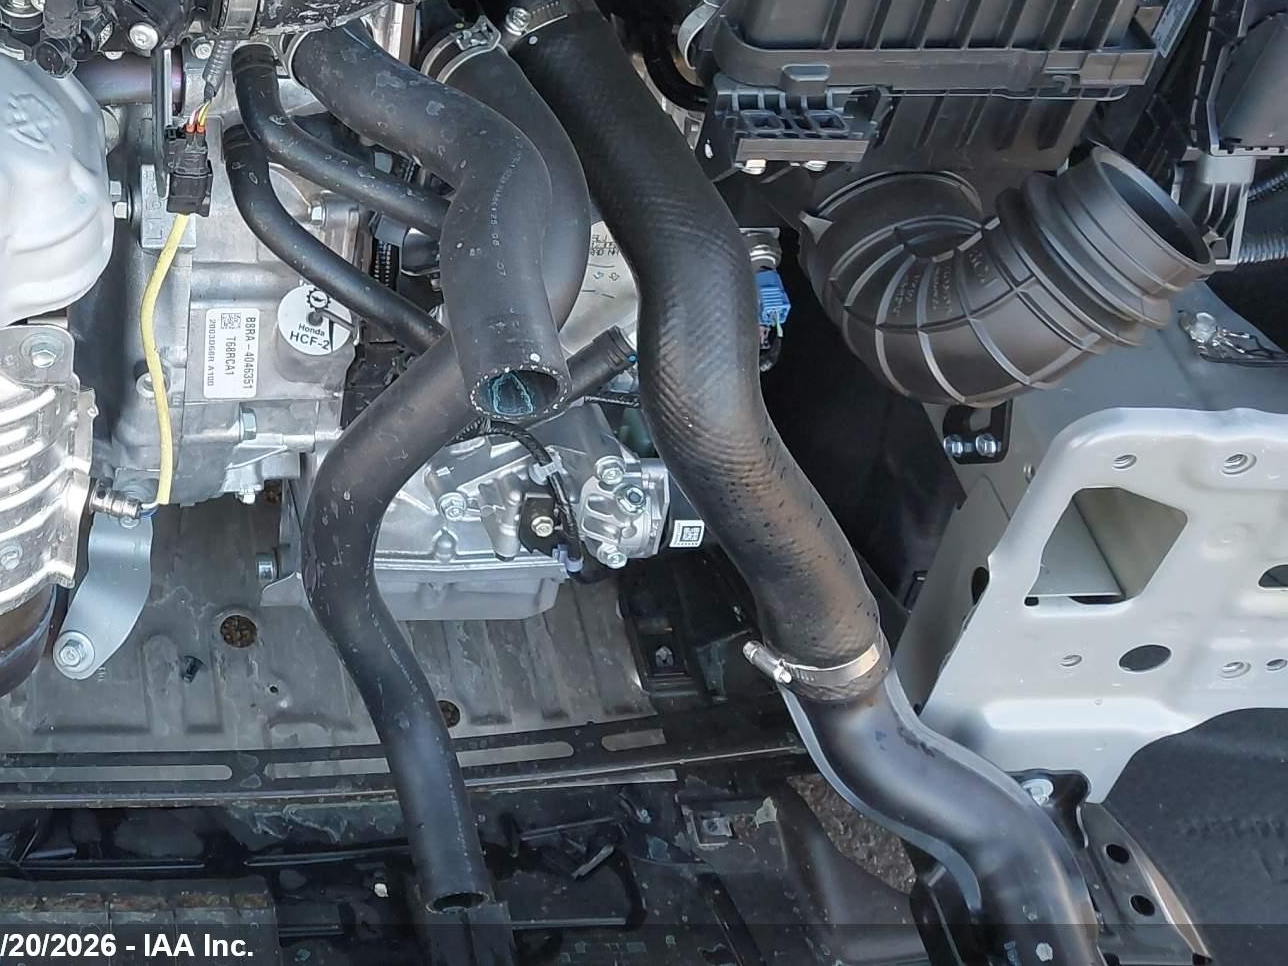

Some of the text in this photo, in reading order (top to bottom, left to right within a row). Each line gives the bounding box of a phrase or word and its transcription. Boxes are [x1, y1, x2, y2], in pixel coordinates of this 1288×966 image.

[298, 323, 325, 337] Honda
[289, 331, 330, 351] HCF-2
[224, 336, 237, 376] T68RCA1
